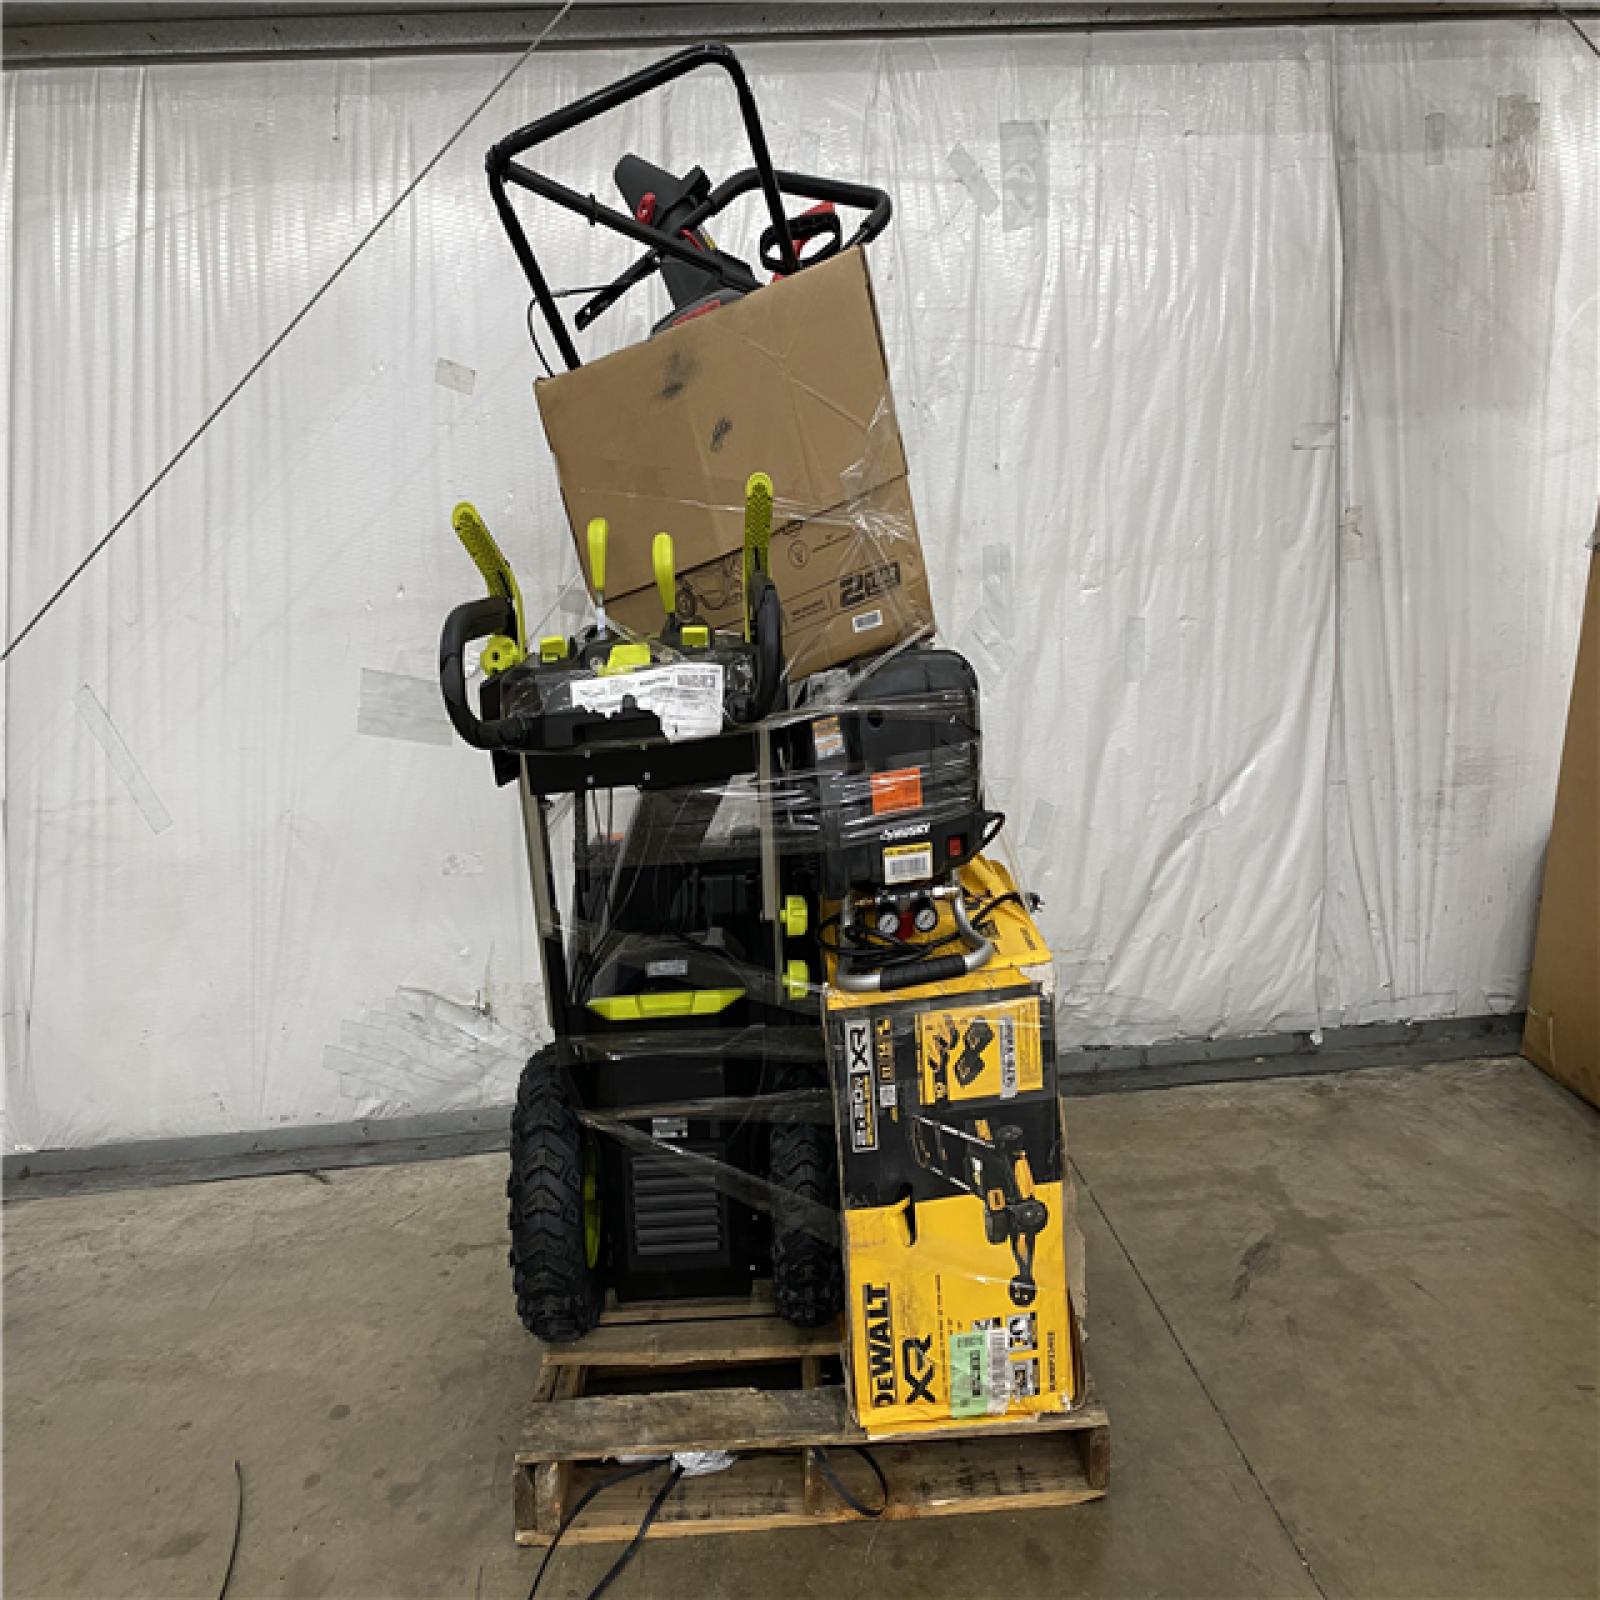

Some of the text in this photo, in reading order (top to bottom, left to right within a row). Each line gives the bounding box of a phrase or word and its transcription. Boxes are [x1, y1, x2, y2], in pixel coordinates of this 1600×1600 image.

[850, 1026, 868, 1068] XR
[864, 1284, 893, 1407] DEWALT
[902, 1334, 935, 1404] XR
